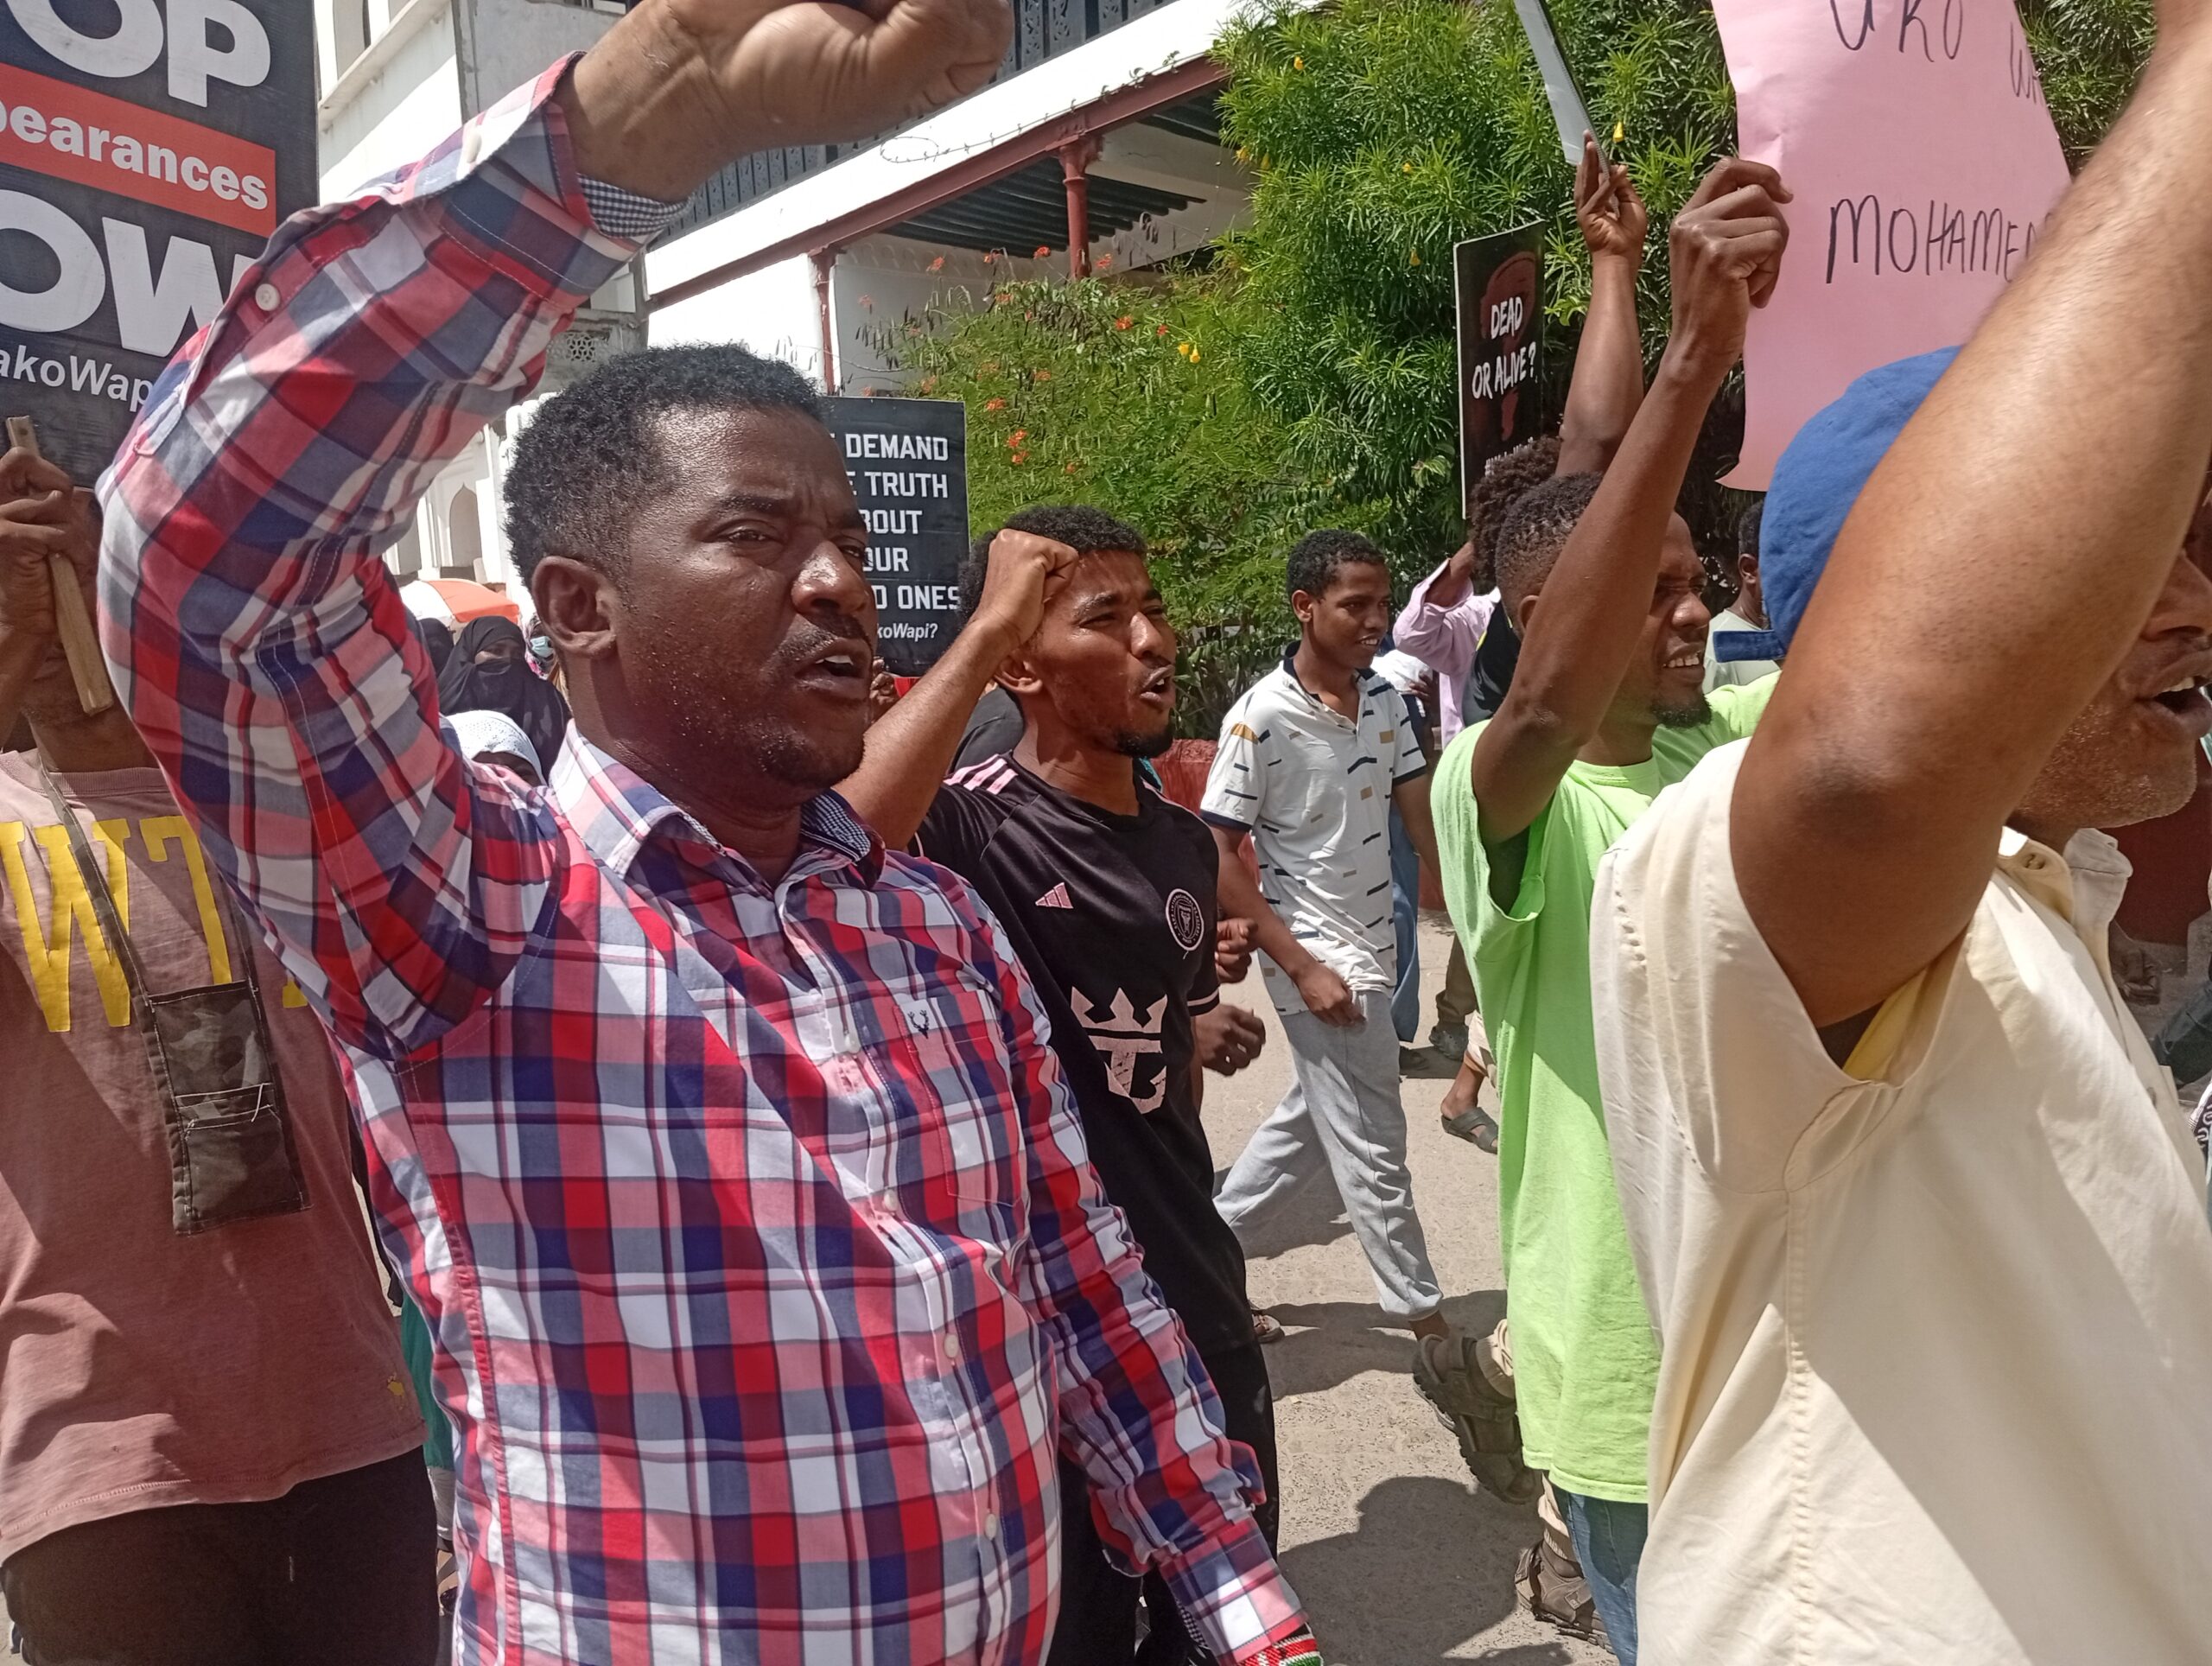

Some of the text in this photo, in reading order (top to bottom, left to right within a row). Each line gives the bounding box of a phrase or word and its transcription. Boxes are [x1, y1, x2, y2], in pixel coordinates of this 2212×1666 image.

[0, 100, 268, 210] earances
[1491, 296, 1522, 340] DEAD
[1471, 361, 1493, 400] OR
[845, 434, 949, 461] DEMAND
[864, 472, 949, 499] TRUTH
[897, 585, 961, 610] ONES
